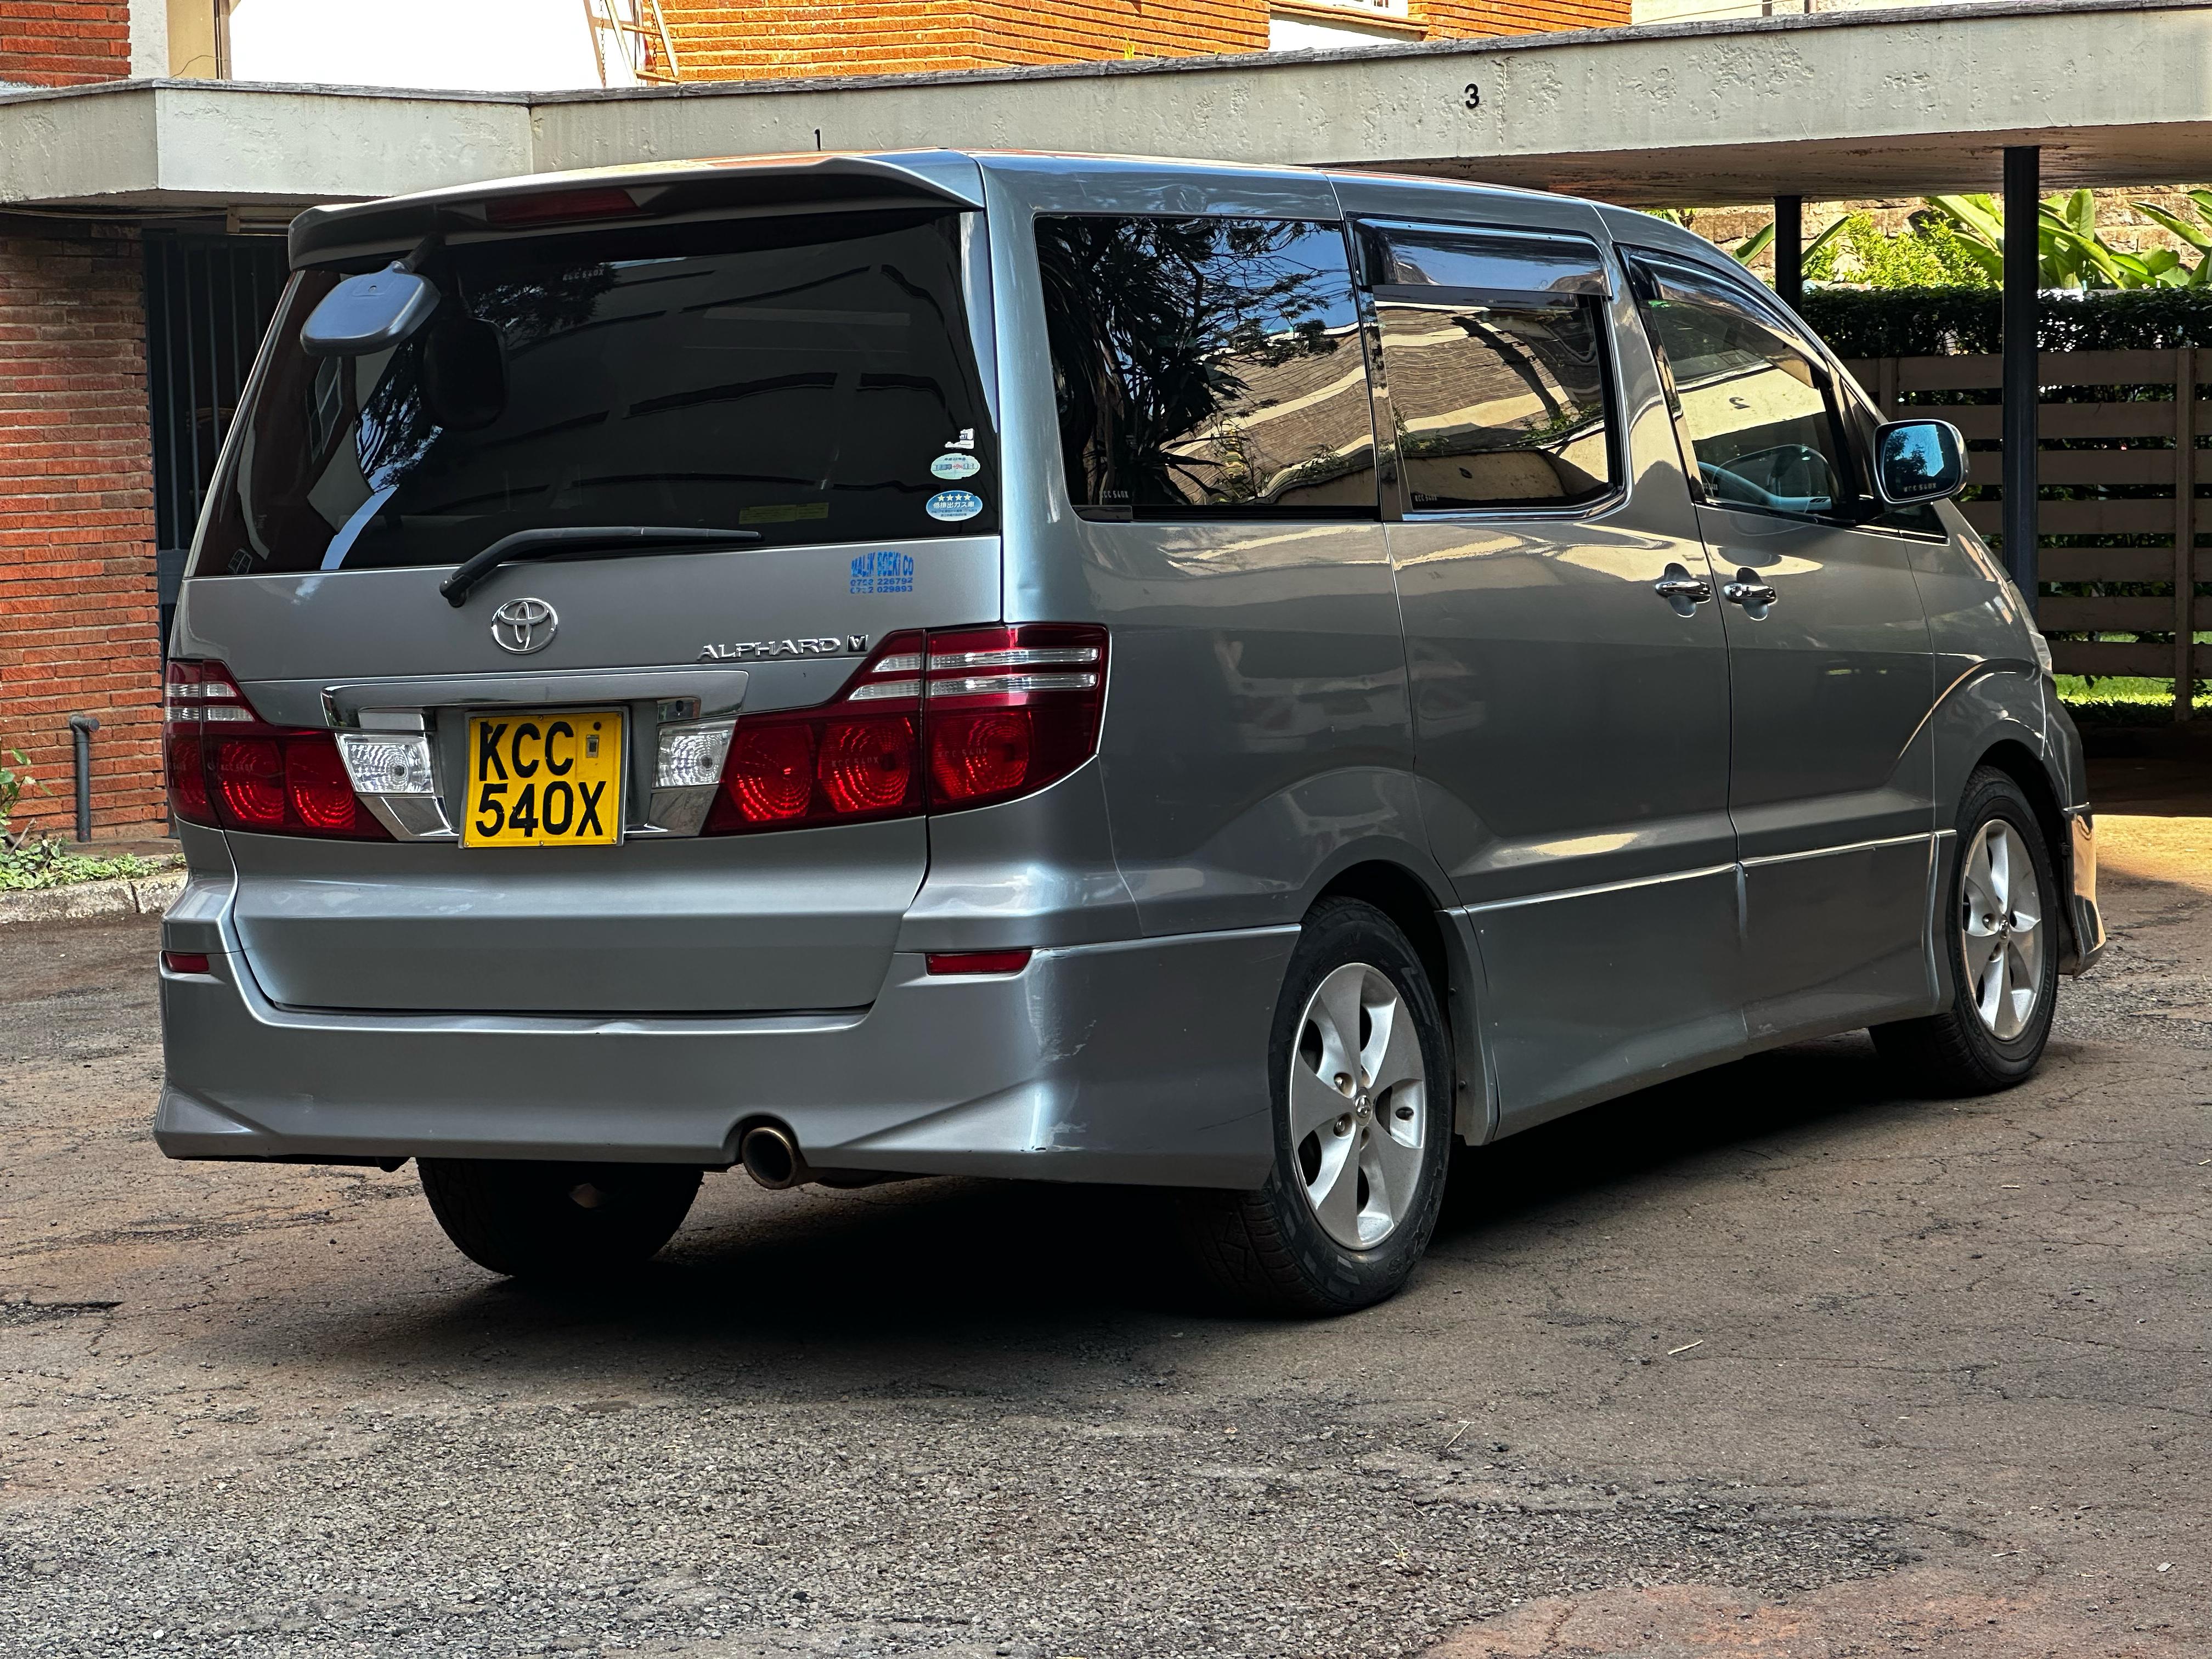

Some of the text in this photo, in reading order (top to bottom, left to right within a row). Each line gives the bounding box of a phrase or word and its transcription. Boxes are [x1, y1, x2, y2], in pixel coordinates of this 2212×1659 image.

[1464, 83, 1480, 109] 3
[814, 128, 821, 151] 1
[851, 552, 875, 577] MALIK
[903, 555, 913, 575] CO
[697, 637, 840, 661] ALPHARD
[479, 721, 574, 781] KCC
[476, 781, 606, 838] 540X
